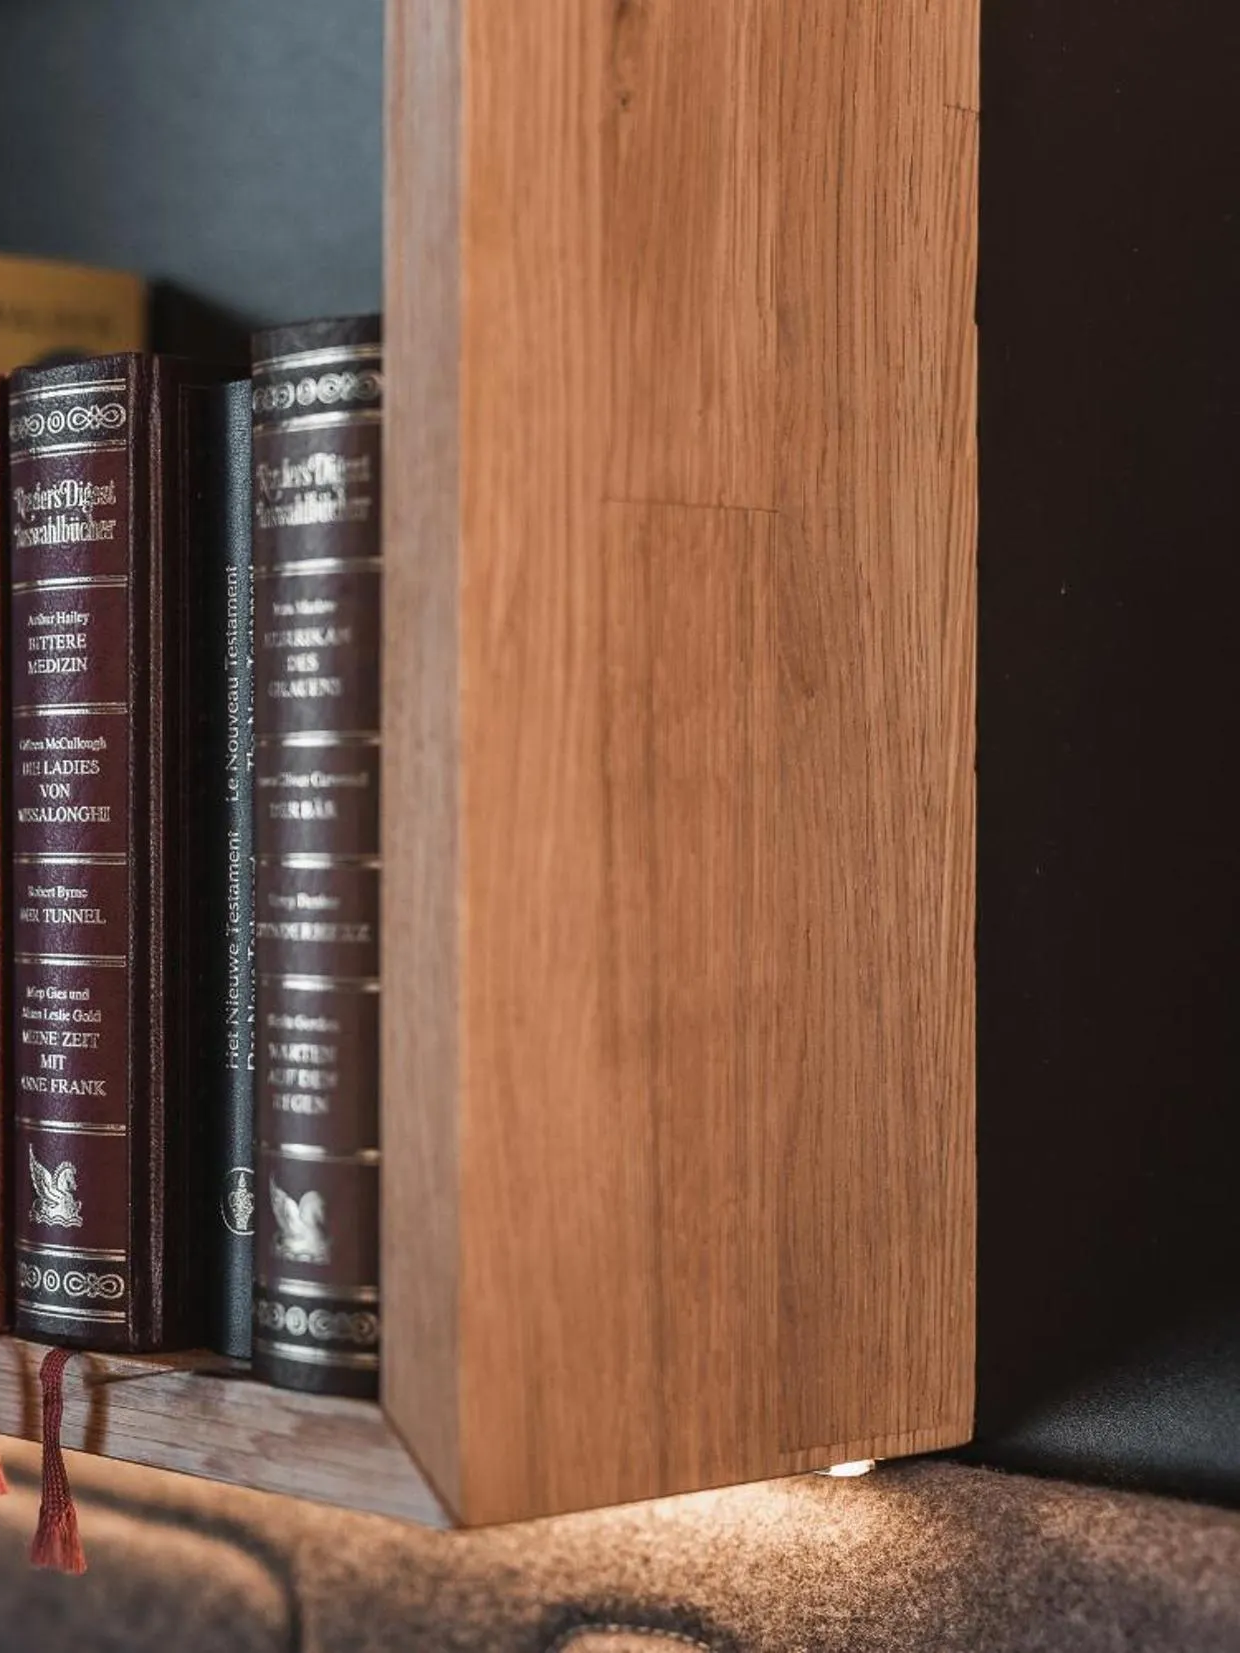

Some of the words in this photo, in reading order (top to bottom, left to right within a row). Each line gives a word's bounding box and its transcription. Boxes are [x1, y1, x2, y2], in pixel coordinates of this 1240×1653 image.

[223, 564, 240, 671] Testament
[27, 632, 88, 651] BITTERE
[27, 657, 89, 675] MEDIZIN
[224, 676, 240, 771] Nouveau
[43, 759, 101, 775] LADIES
[39, 782, 71, 800] VON
[224, 778, 240, 802] Le
[224, 829, 240, 938] Testament
[42, 908, 107, 924] TUNNEL
[224, 943, 240, 1024] Nieuwe
[69, 987, 91, 1001] und
[61, 1031, 102, 1049] ZEIT
[225, 1031, 240, 1071] Het
[40, 1052, 68, 1071] MIT
[50, 1078, 108, 1097] FRANK
